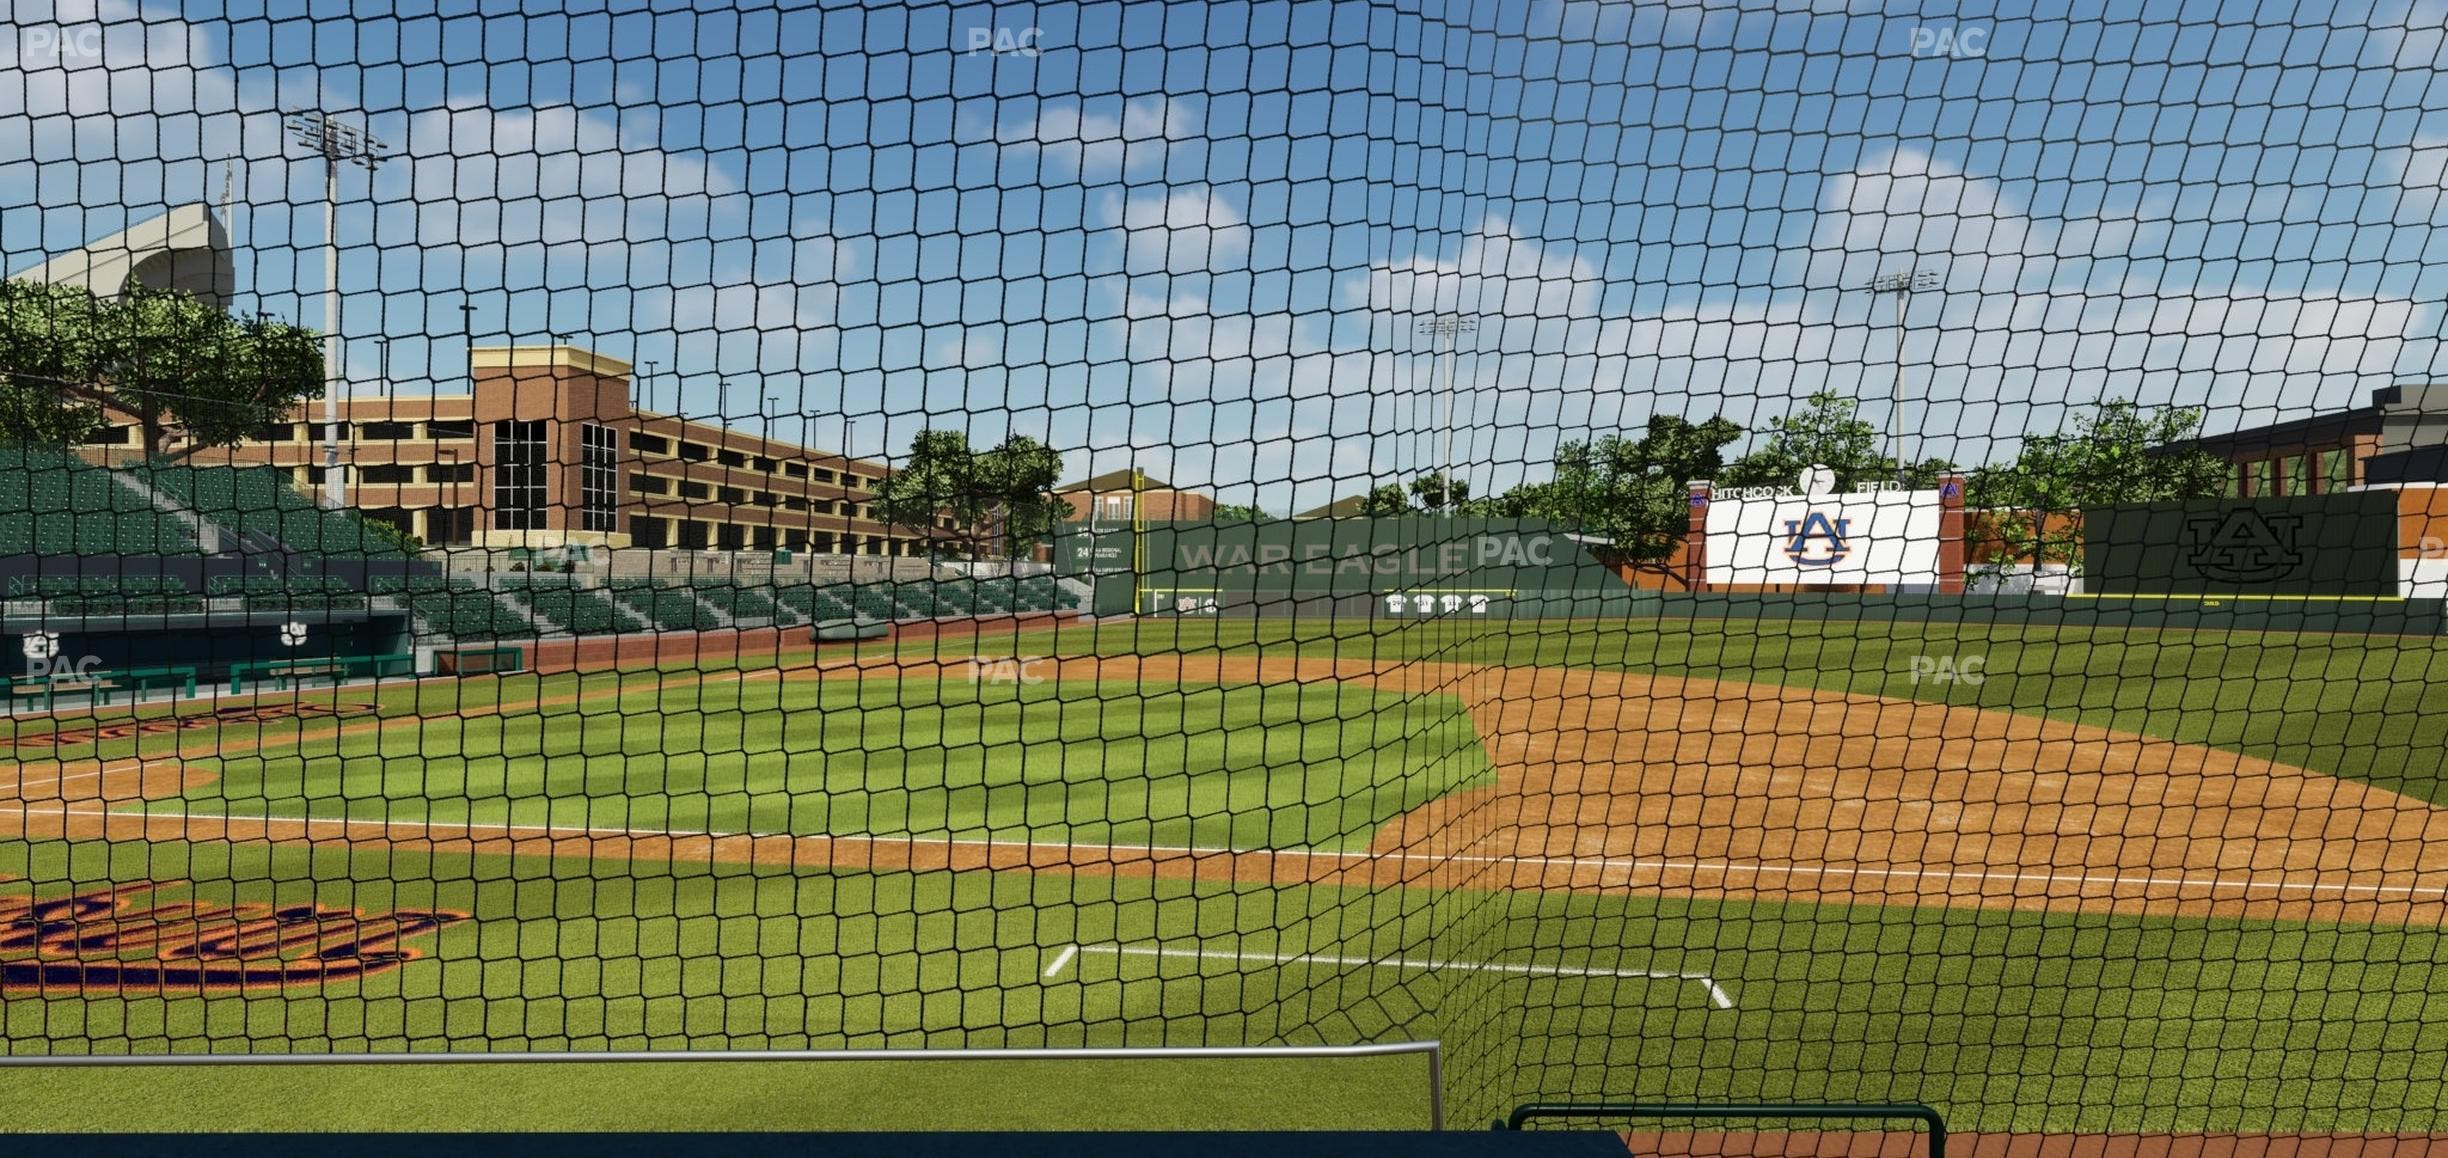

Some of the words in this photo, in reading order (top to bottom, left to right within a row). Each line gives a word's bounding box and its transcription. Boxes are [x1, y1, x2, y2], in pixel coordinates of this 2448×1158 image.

[1712, 486, 1794, 499] HITCHCOCK
[1856, 481, 1901, 493] FIELD
[1077, 547, 1089, 558] 24
[1181, 544, 1291, 575] WAR
[1306, 544, 1469, 575] EAGLE
